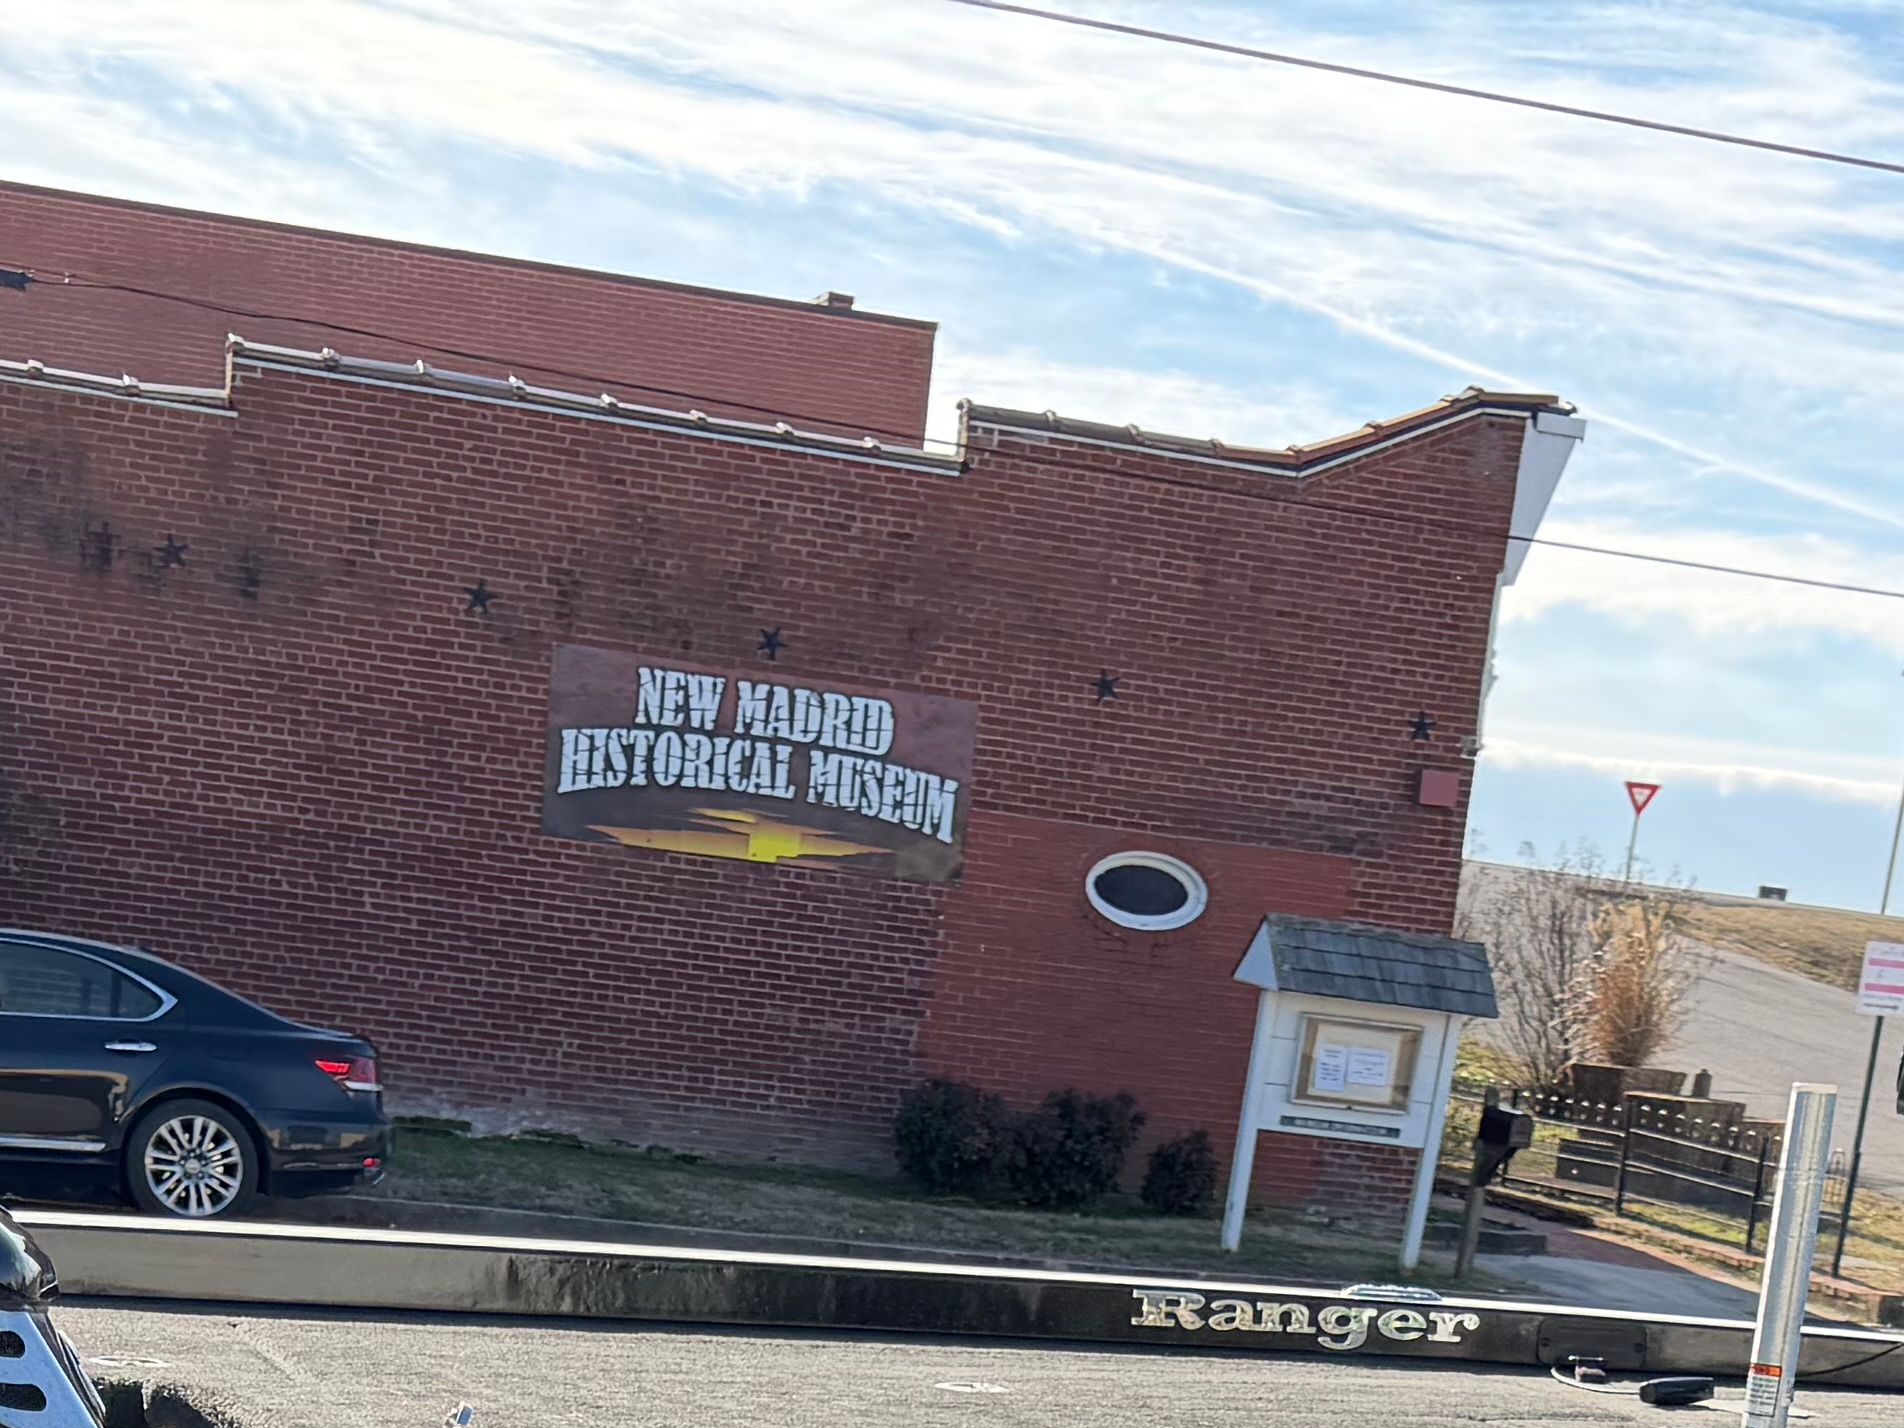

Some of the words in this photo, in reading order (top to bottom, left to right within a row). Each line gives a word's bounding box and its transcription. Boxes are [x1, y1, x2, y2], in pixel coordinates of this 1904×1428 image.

[636, 665, 728, 733] NEW
[735, 679, 895, 757] MADRID
[556, 726, 797, 801] HISTORICAL
[806, 751, 960, 845] MUSEUM
[1130, 1287, 1481, 1351] Ranger
